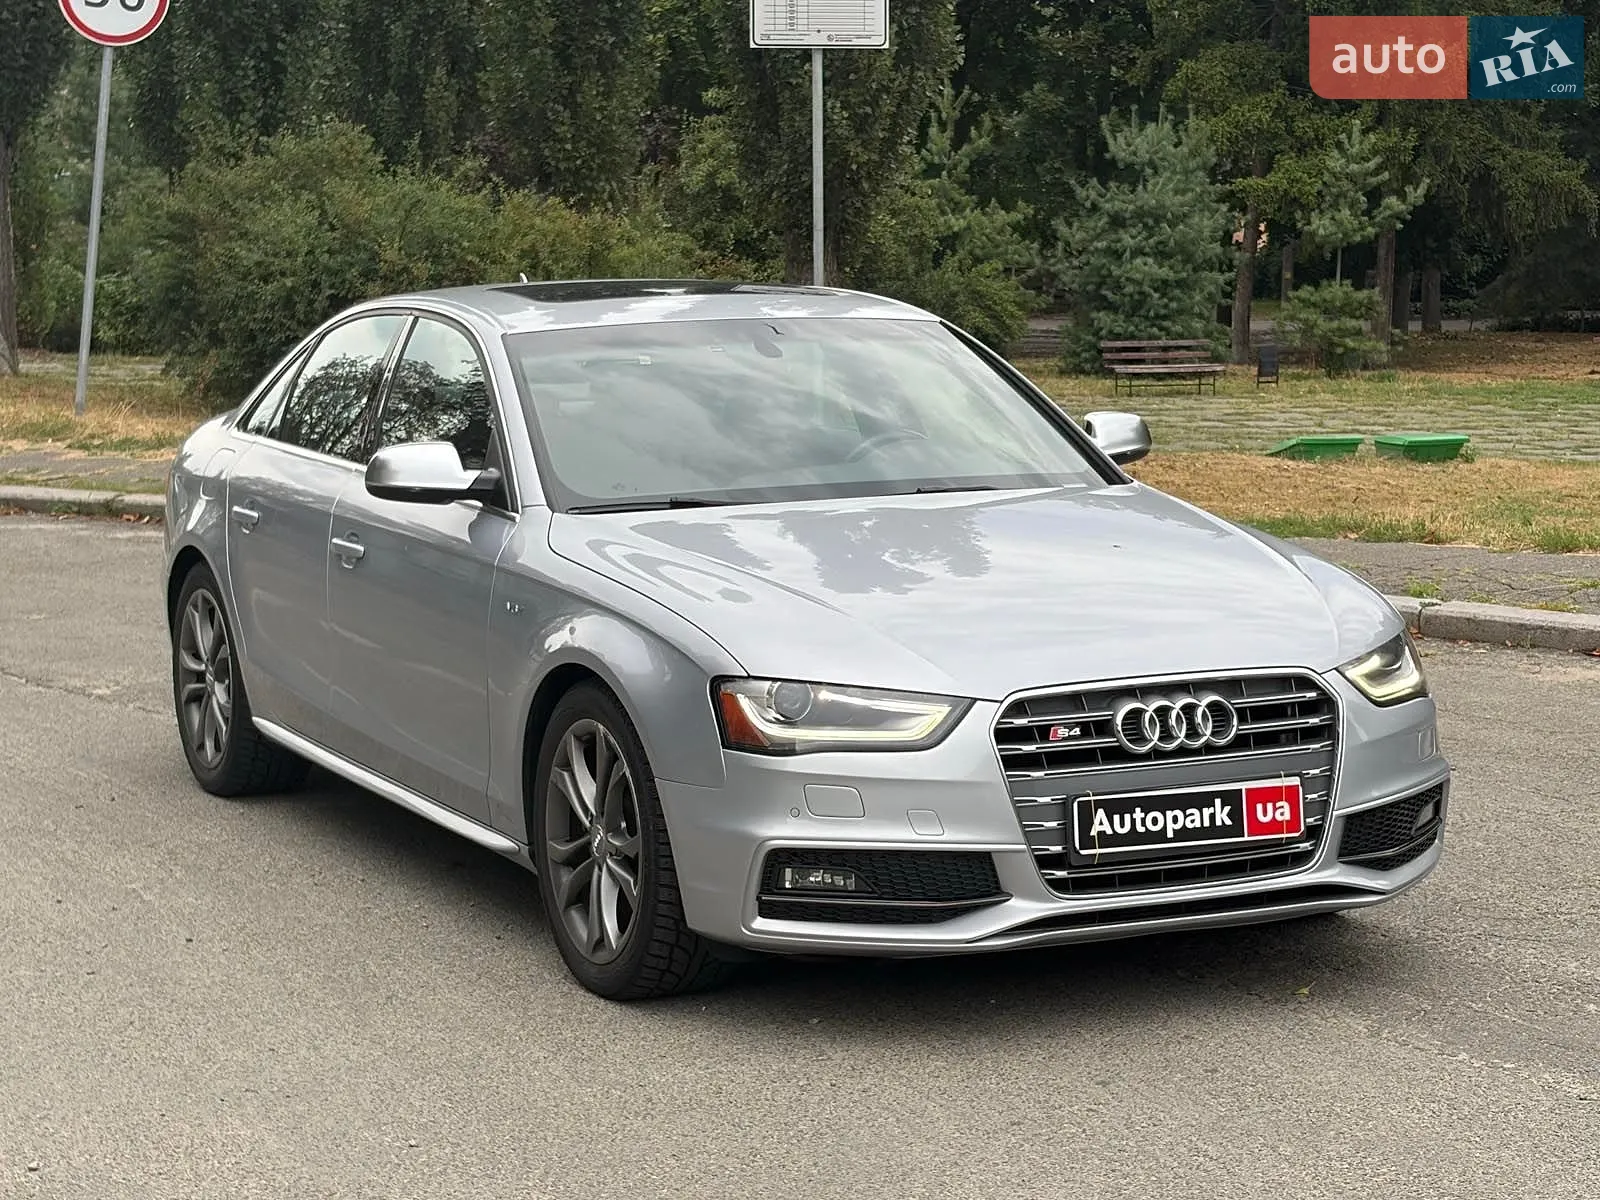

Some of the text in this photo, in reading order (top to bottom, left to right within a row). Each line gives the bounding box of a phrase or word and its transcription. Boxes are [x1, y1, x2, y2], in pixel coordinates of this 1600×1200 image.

[1056, 727, 1081, 738] S4
[1089, 798, 1291, 838] Autopark ua
